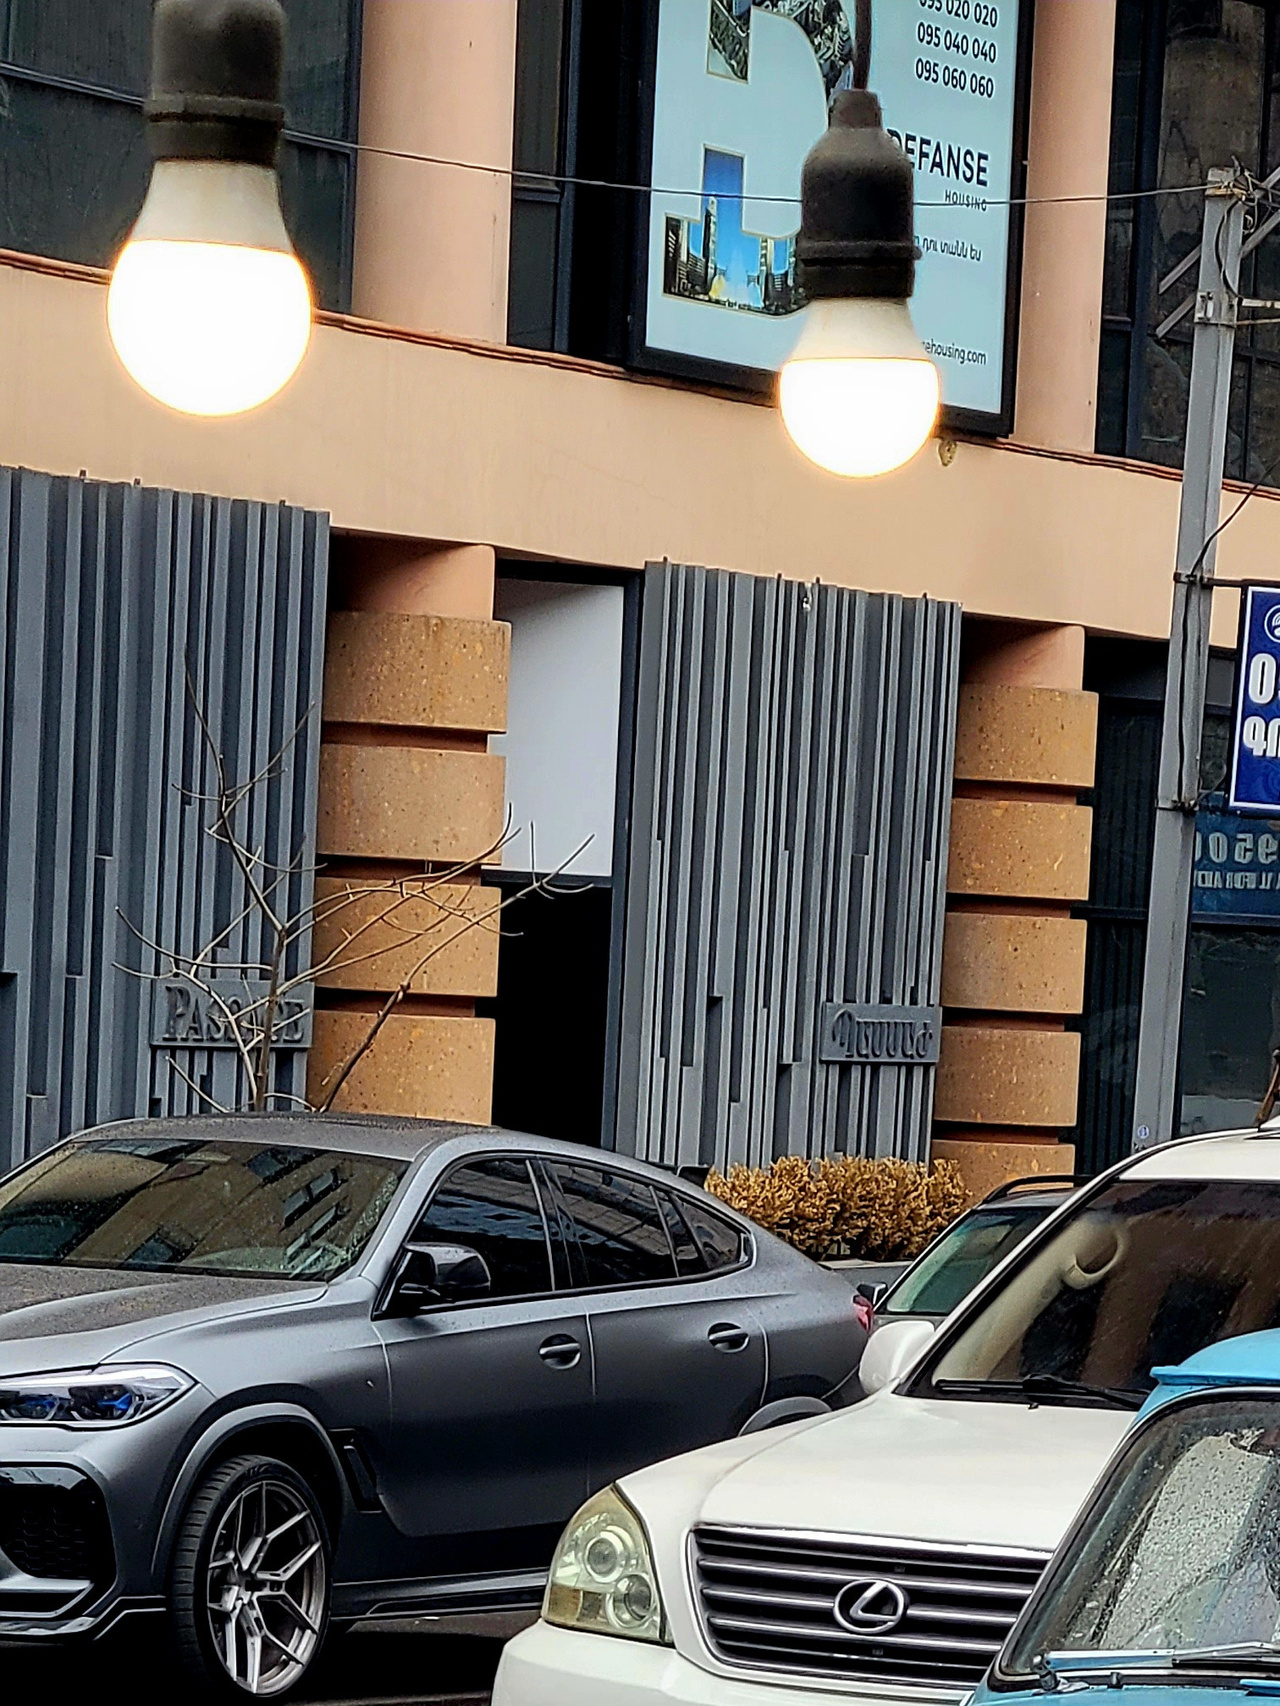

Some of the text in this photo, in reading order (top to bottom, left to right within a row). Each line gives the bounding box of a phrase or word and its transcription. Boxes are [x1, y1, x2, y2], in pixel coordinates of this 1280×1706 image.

[945, 0, 970, 21] 020
[973, 2, 998, 28] 020
[917, 21, 997, 64] 095 040 040
[915, 57, 994, 99] 095 060 060
[944, 189, 987, 212] HOUSING
